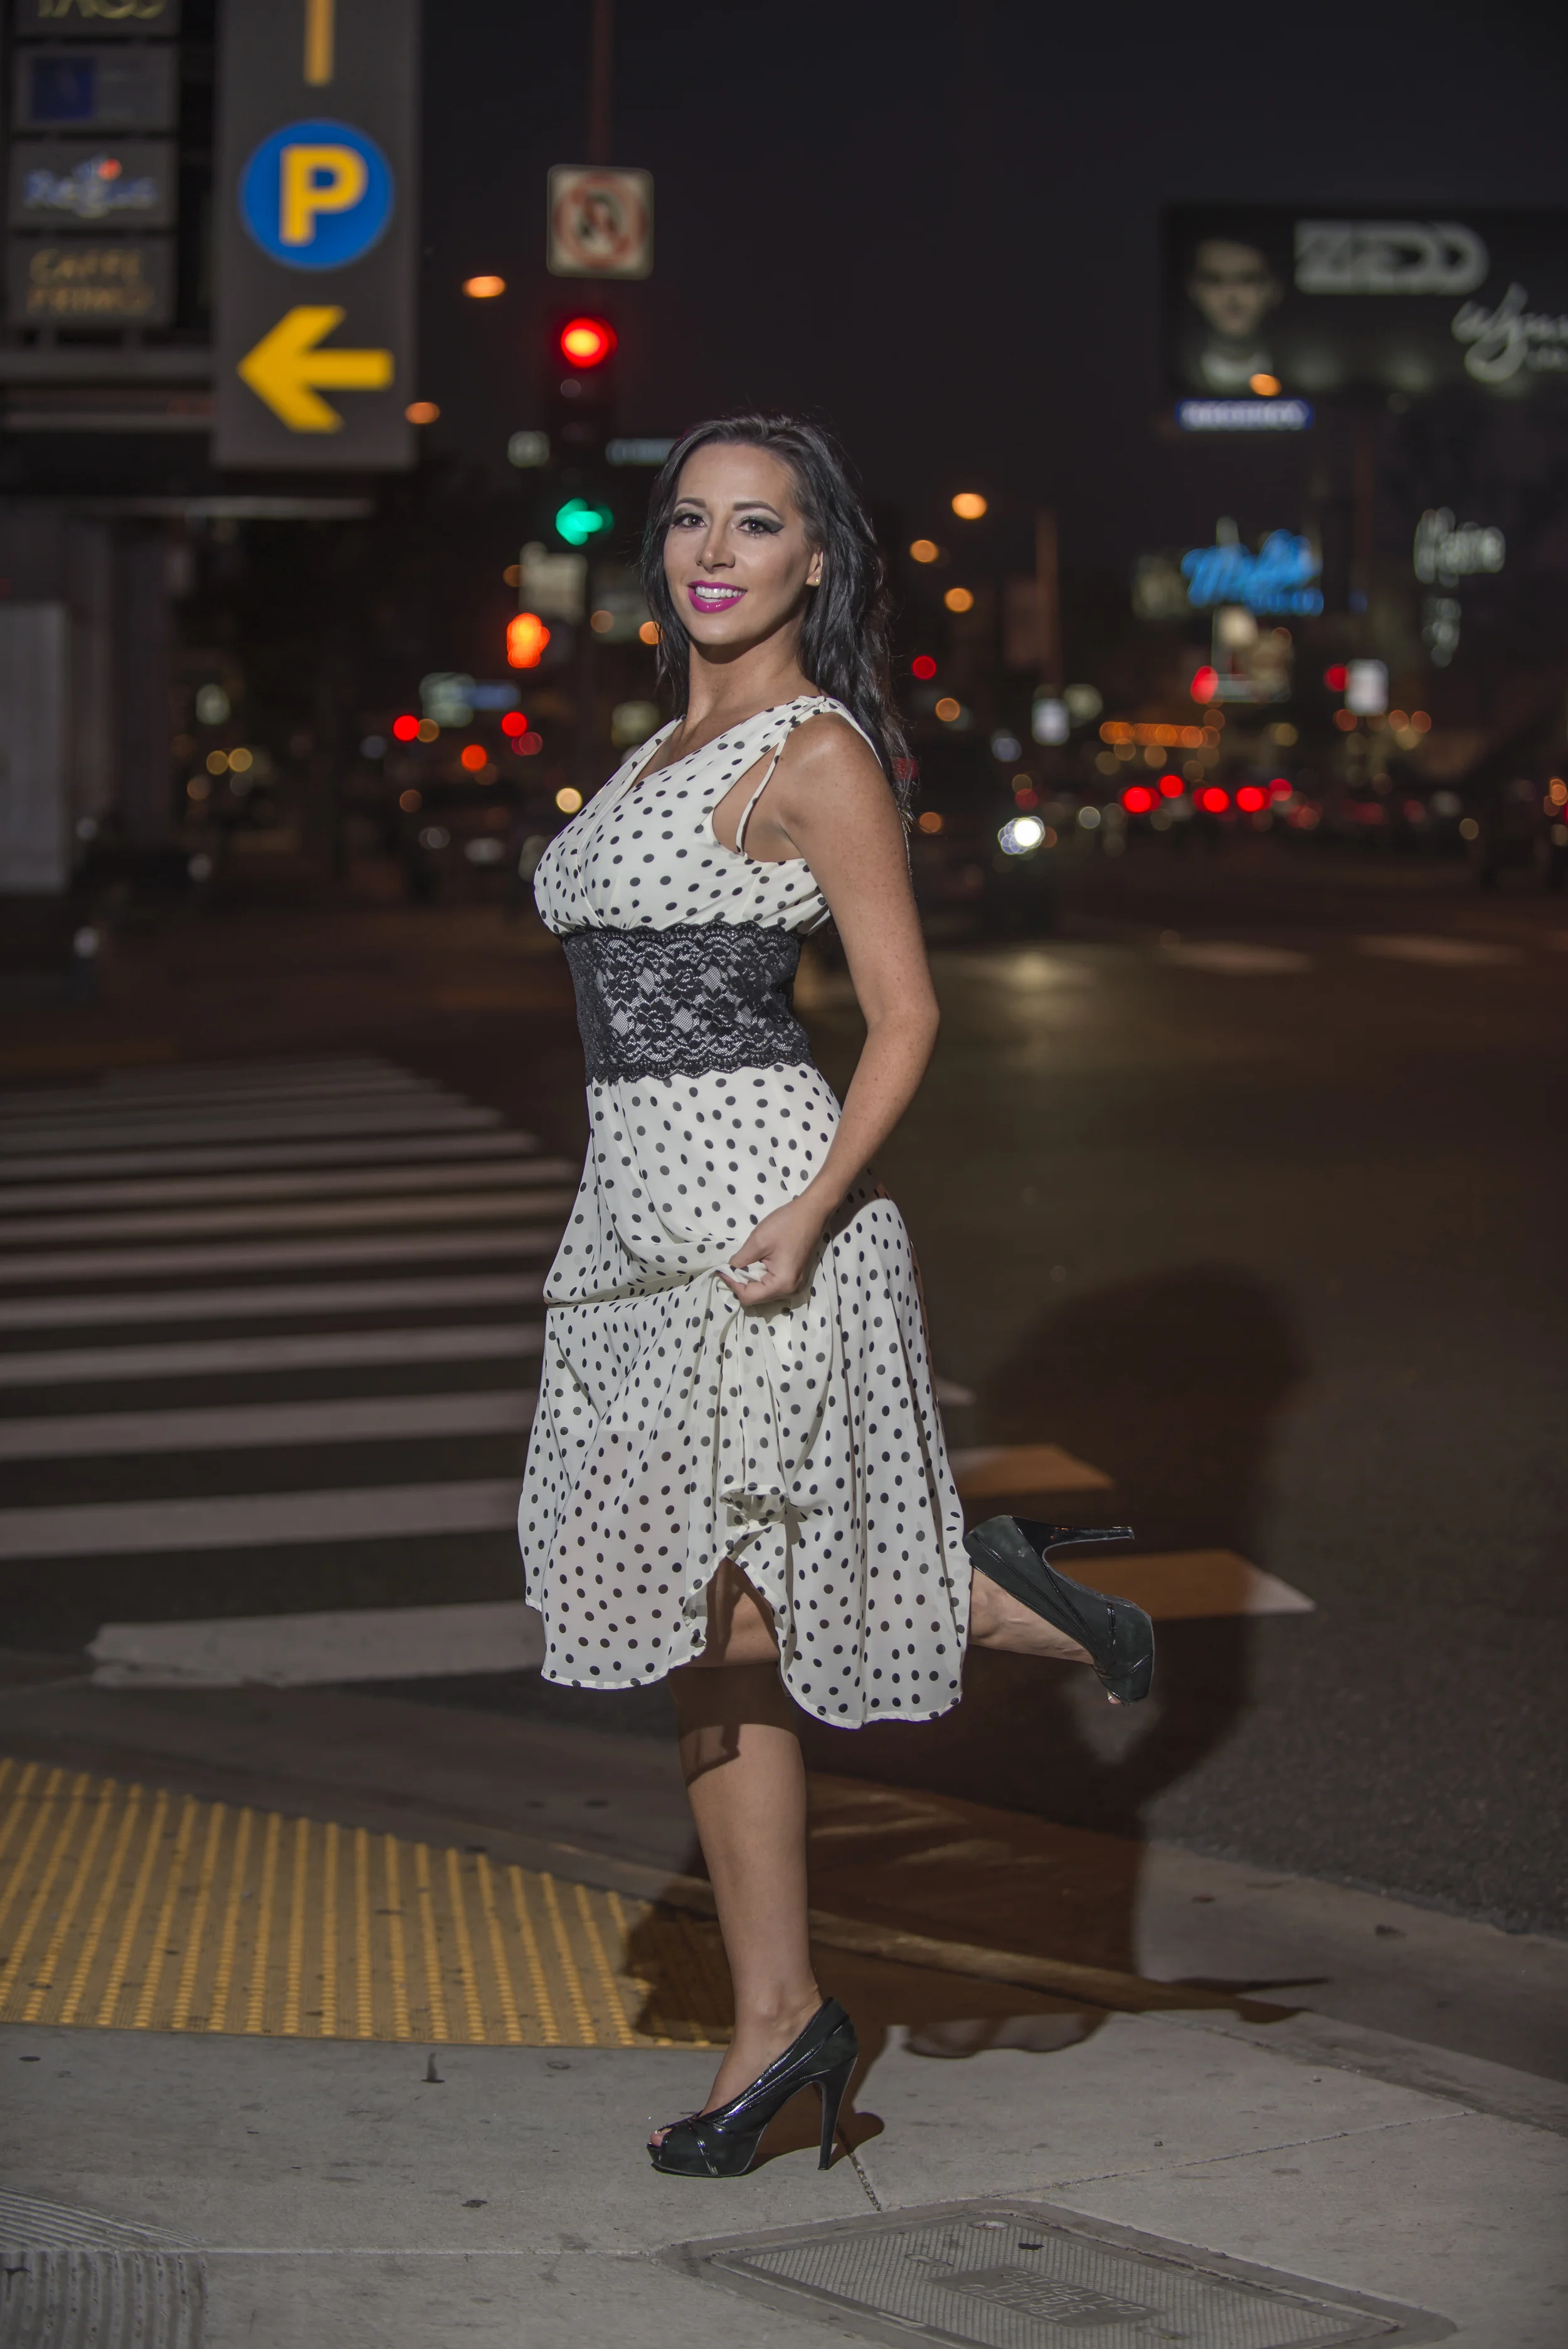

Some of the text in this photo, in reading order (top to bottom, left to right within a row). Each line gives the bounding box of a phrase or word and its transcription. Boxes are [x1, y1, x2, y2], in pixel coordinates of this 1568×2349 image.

[279, 144, 368, 247] P
[959, 2284, 1071, 2321] TRAFFIC
[995, 2281, 1096, 2313] SIGNAL
